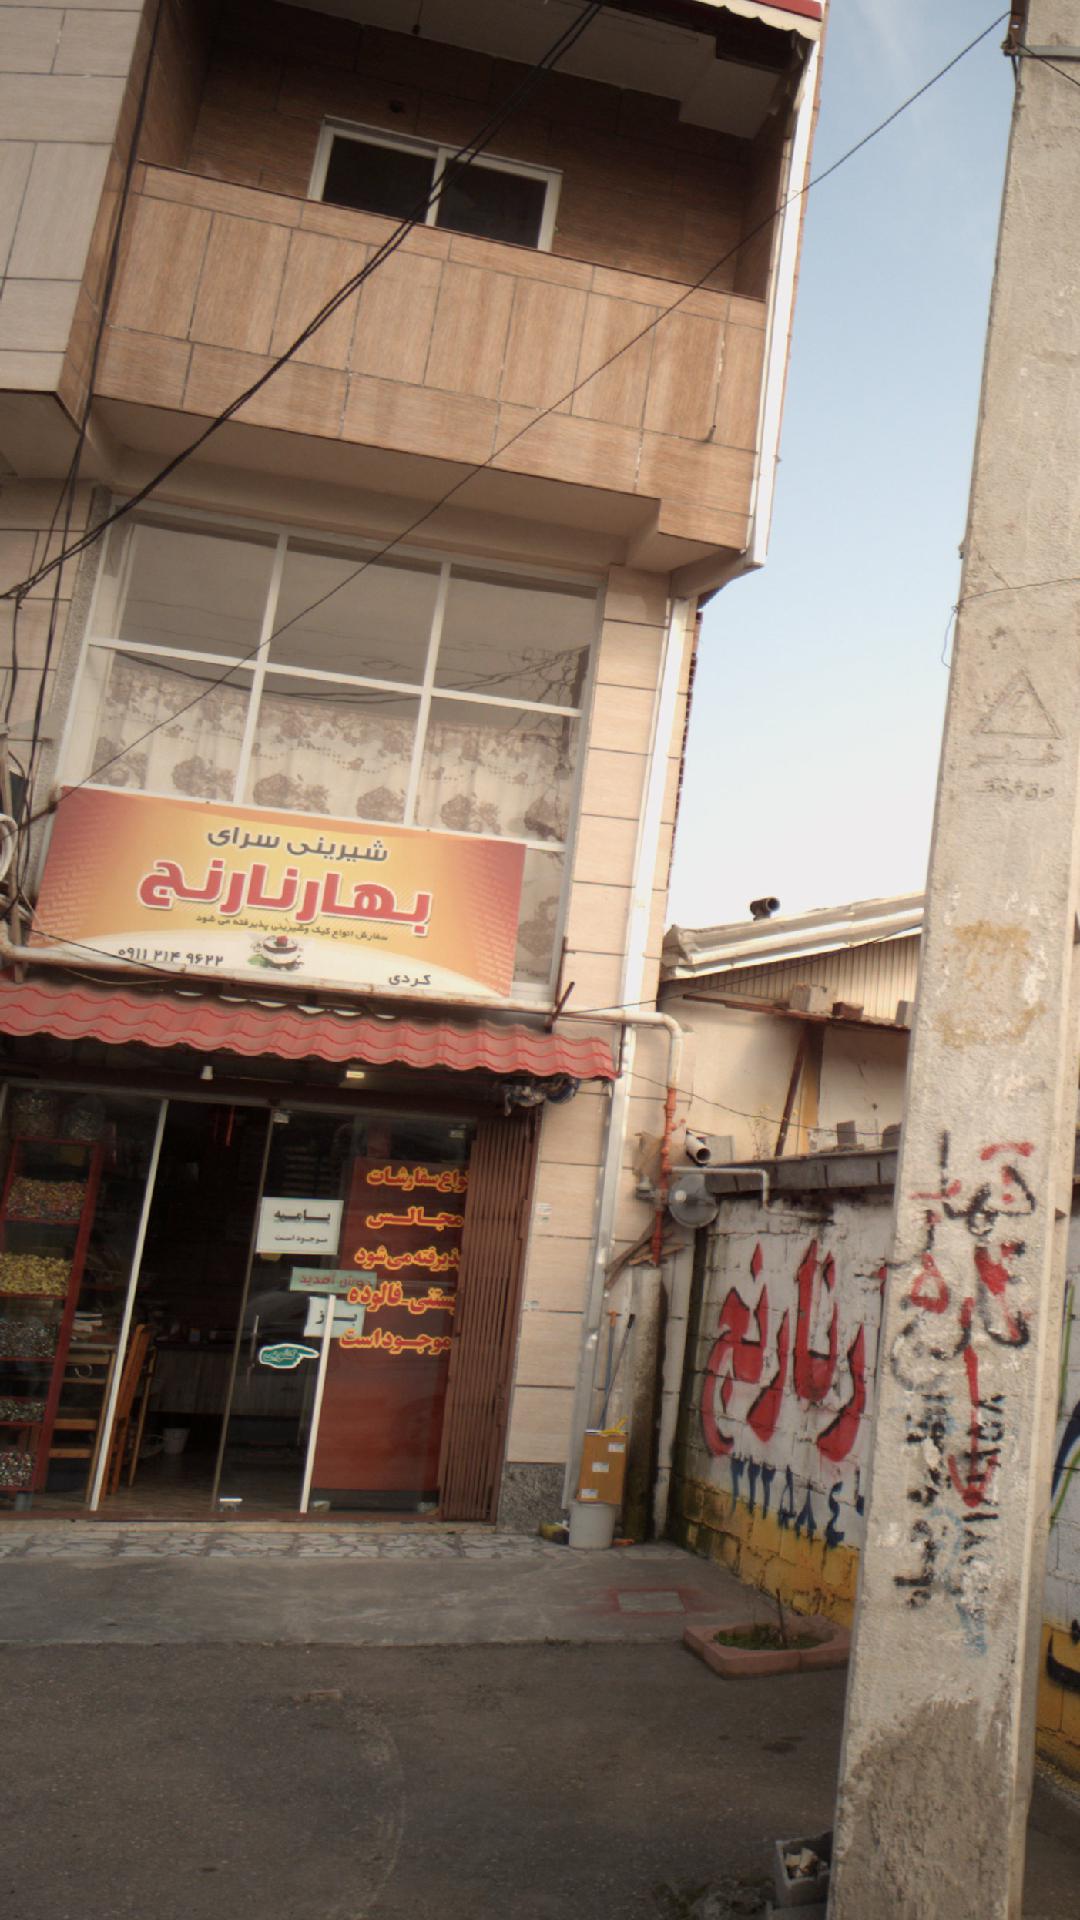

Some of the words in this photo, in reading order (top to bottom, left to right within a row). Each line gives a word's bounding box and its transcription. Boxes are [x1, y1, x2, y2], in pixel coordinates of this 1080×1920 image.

[206, 826, 279, 849] سرای
[287, 837, 388, 863] شیرینی
[138, 858, 433, 935] بهارنارنج
[196, 914, 216, 924] شود
[311, 926, 331, 936] کیک
[331, 928, 354, 939] انواع
[355, 930, 388, 941] سفارش
[388, 974, 432, 987] کردی
[366, 1165, 438, 1191] سفارشات
[354, 1245, 388, 1269] شود
[387, 1252, 412, 1270] می
[314, 1309, 358, 1327] بز
[339, 1328, 383, 1350] است
[382, 1332, 451, 1355] موجود
